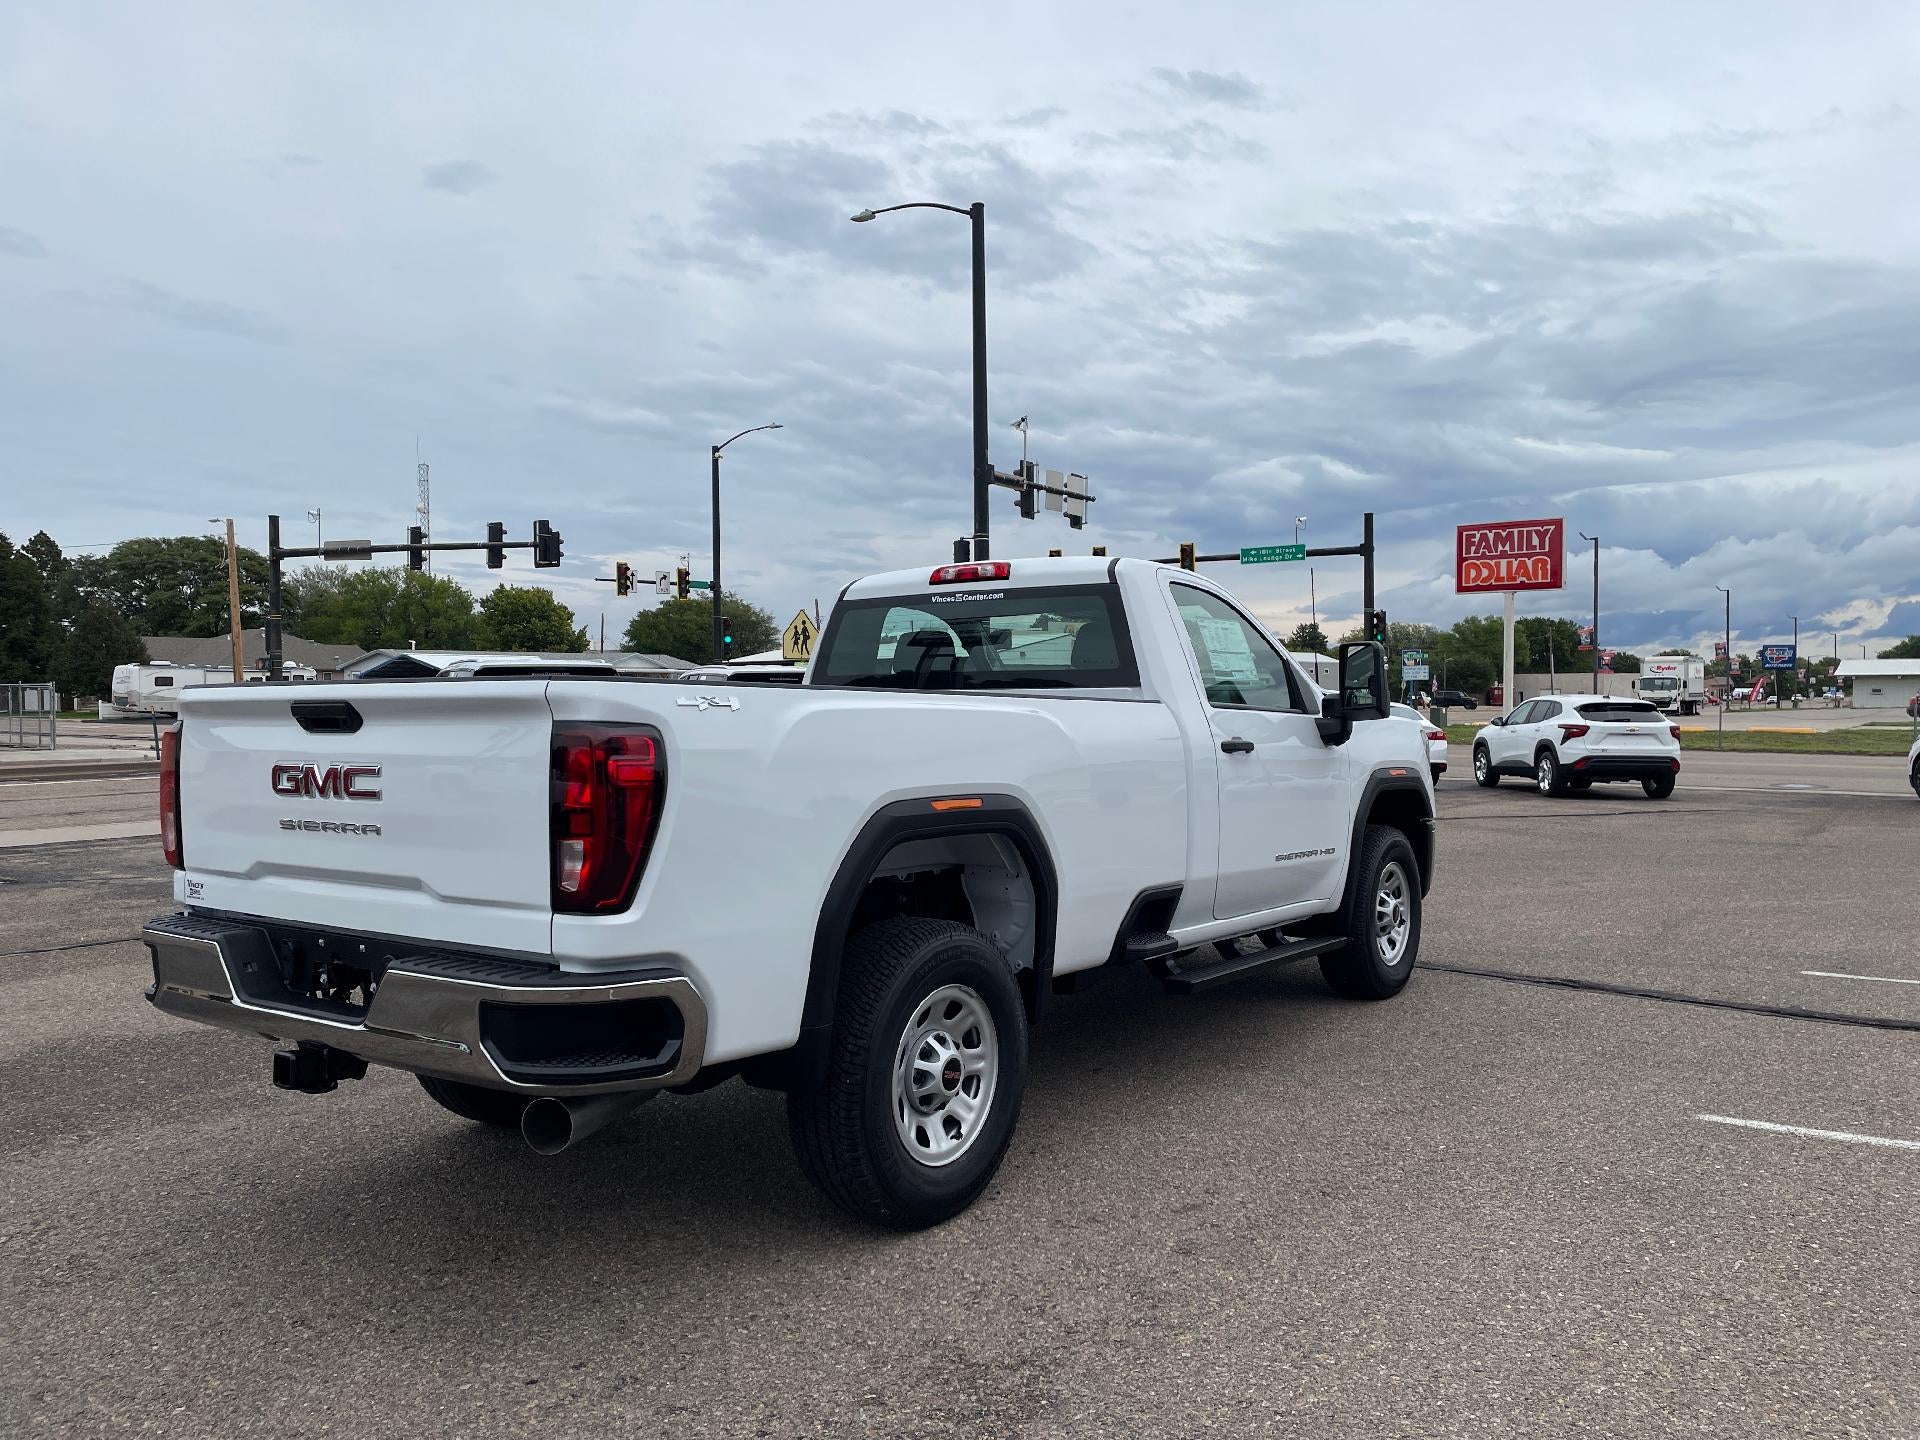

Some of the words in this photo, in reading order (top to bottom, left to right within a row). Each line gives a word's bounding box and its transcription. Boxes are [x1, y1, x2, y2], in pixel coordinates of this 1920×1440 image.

[1463, 526, 1555, 557] FAMILY
[1462, 556, 1550, 586] DOLLAR
[272, 760, 382, 801] GMC
[279, 818, 382, 836] SIERRA
[1275, 849, 1318, 862] SIERRA
[1319, 847, 1336, 856] HD
